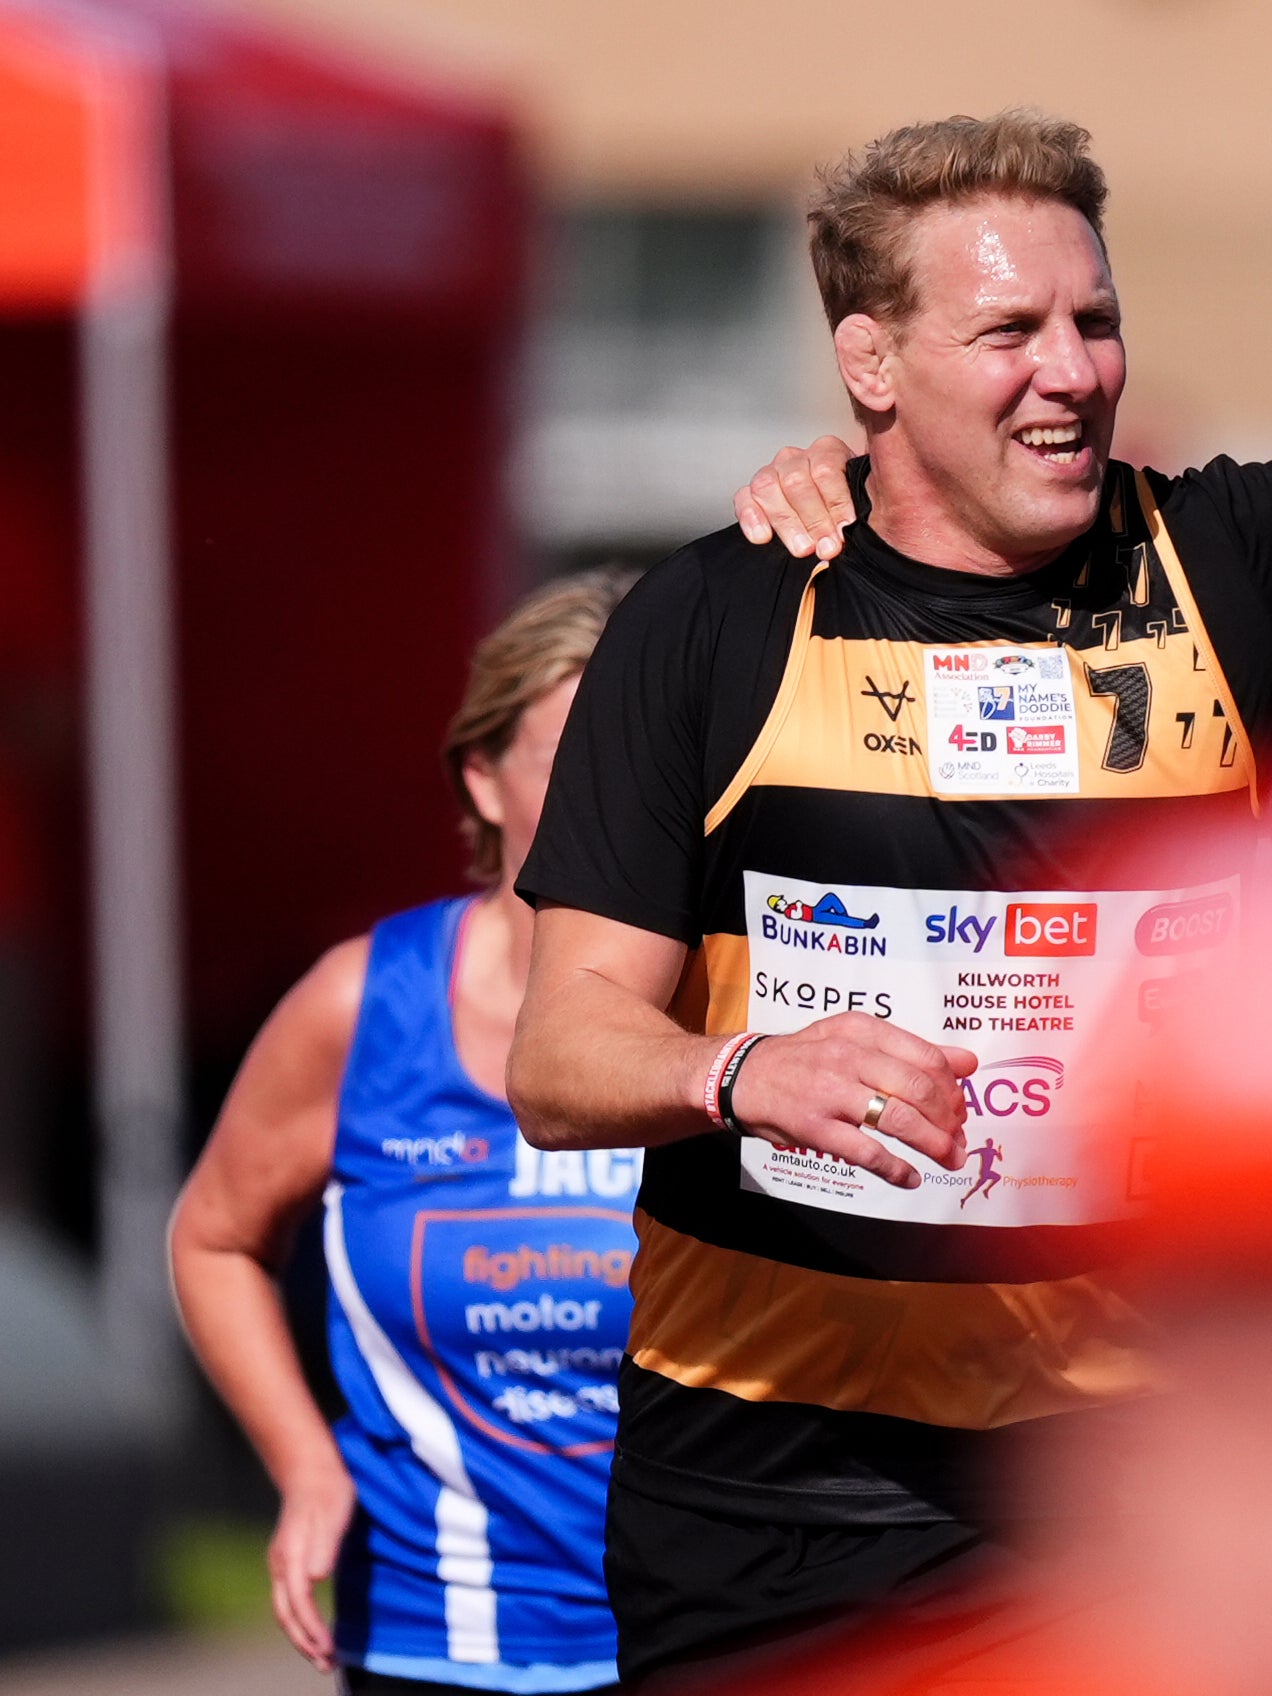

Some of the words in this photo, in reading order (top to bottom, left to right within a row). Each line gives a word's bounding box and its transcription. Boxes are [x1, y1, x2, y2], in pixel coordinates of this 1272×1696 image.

[933, 654, 989, 672] MND
[934, 672, 990, 681] Association
[1018, 683, 1038, 694] MY
[1019, 693, 1067, 704] NAME'S
[1019, 702, 1072, 714] DODDIE
[1082, 661, 1153, 774] 7
[1175, 711, 1196, 750] 7
[762, 914, 887, 957] BUNKABIN
[925, 905, 997, 953] sky
[1014, 907, 1088, 945] bet
[1151, 907, 1227, 943] BOOST
[957, 973, 1060, 988] KILWORTH
[755, 971, 893, 1019] SKOPES
[943, 994, 1007, 1010] HOUSE
[1014, 994, 1074, 1010] HOTEL
[942, 1016, 982, 1032] AND
[989, 1016, 1074, 1032] THEATRE
[958, 1078, 1051, 1117] ACS
[771, 1152, 857, 1179] amtauto.co.uk
[924, 1172, 973, 1187] ProSport
[1002, 1175, 1079, 1190] Physiotherapy
[463, 1245, 632, 1292] fighting
[464, 1292, 602, 1334] motor
